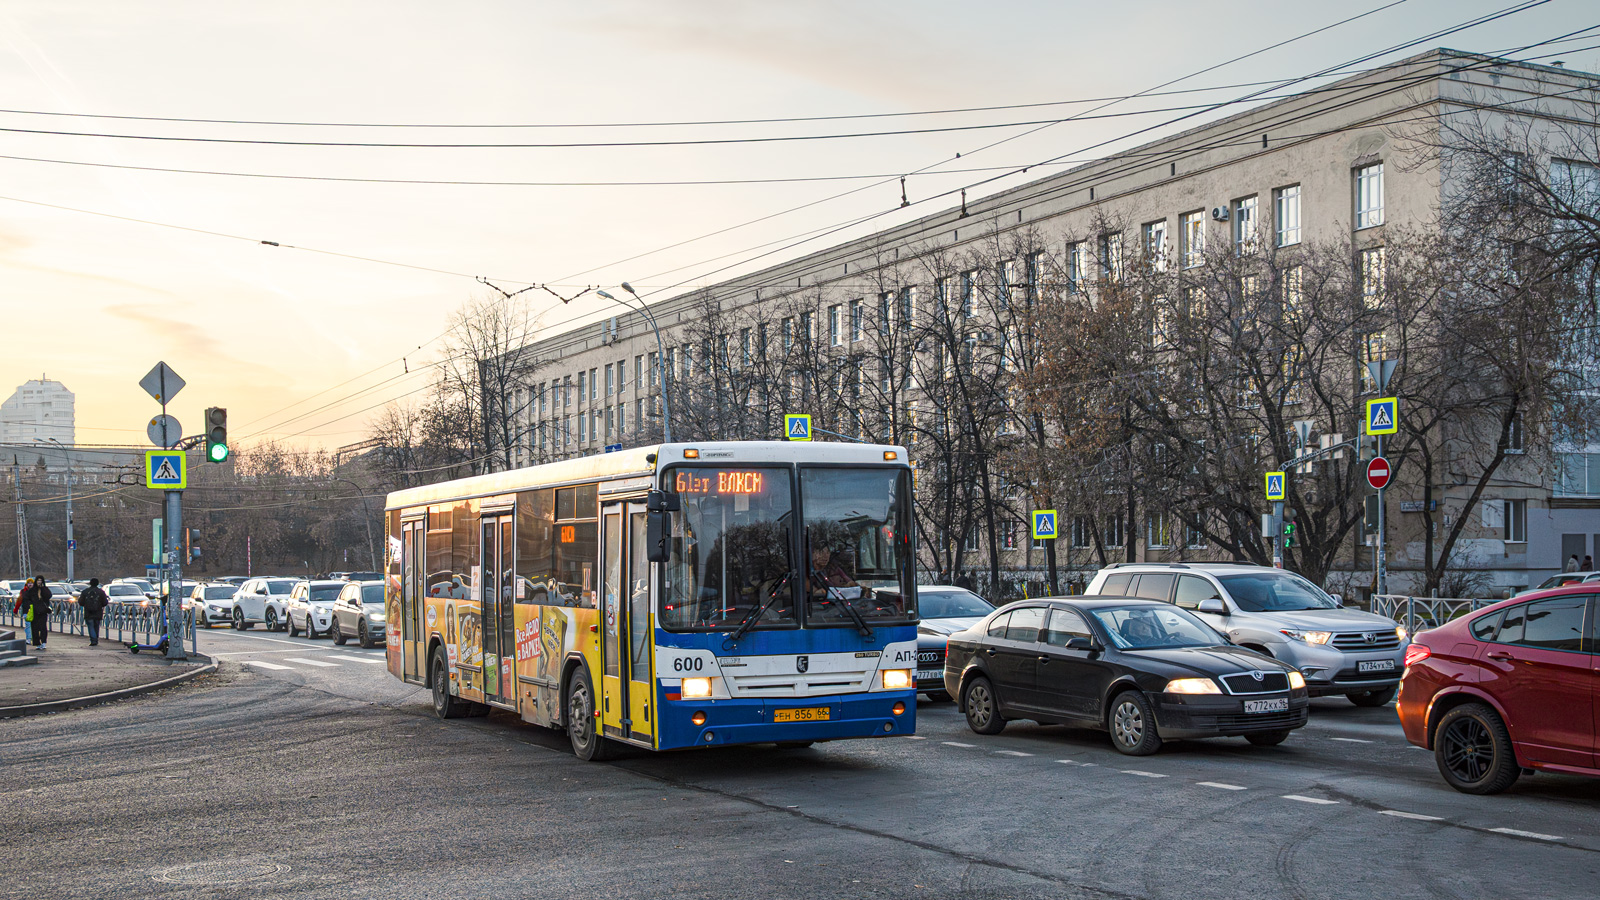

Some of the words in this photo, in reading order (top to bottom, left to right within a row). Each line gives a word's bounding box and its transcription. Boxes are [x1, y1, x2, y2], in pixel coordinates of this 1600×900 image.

[718, 471, 762, 493] ВЛКСМ
[516, 628, 526, 644] Все
[673, 656, 703, 672] 600
[794, 709, 812, 720] 856
[817, 707, 826, 716] 66
